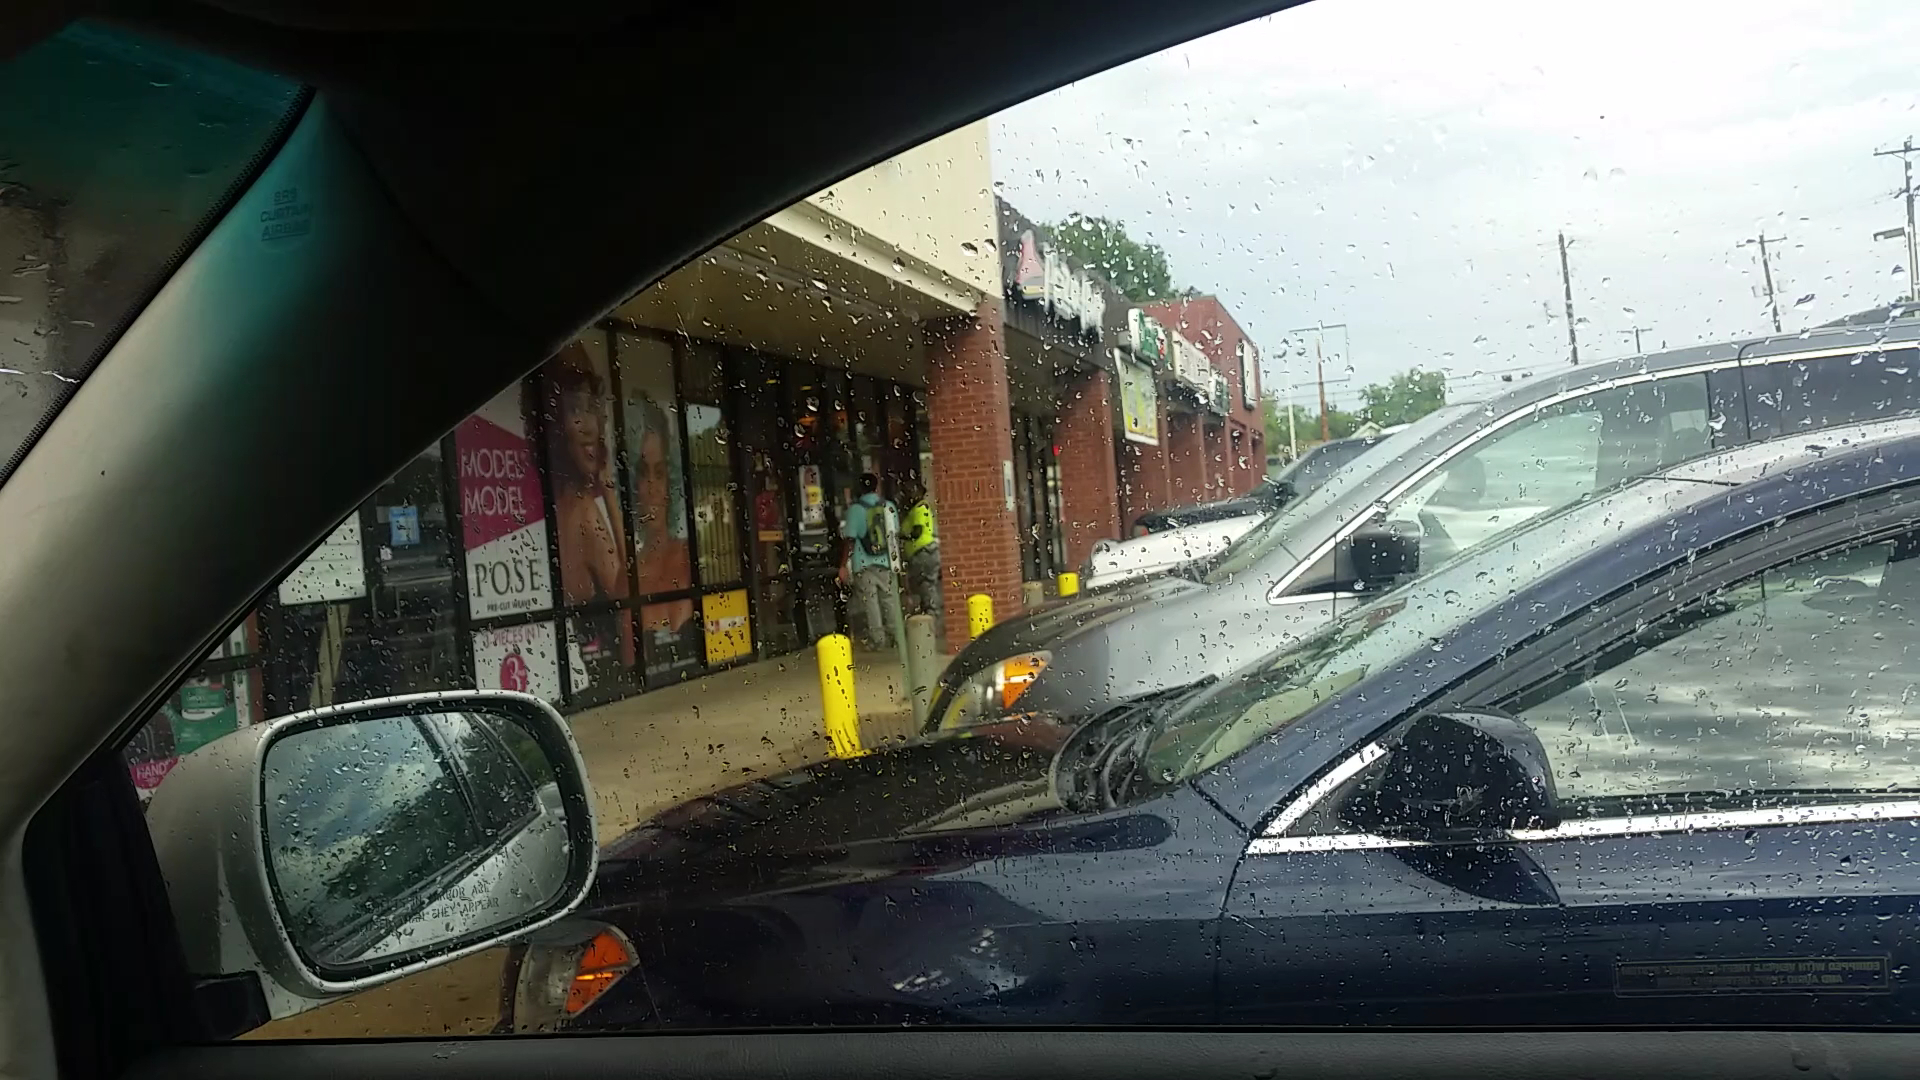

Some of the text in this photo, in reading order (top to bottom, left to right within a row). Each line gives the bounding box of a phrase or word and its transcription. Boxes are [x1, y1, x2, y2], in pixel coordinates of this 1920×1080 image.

[461, 448, 526, 478] MODEL
[464, 485, 527, 516] MODEL
[473, 558, 541, 598] POSE
[136, 762, 167, 781] HAND
[461, 897, 500, 914] APPEAR
